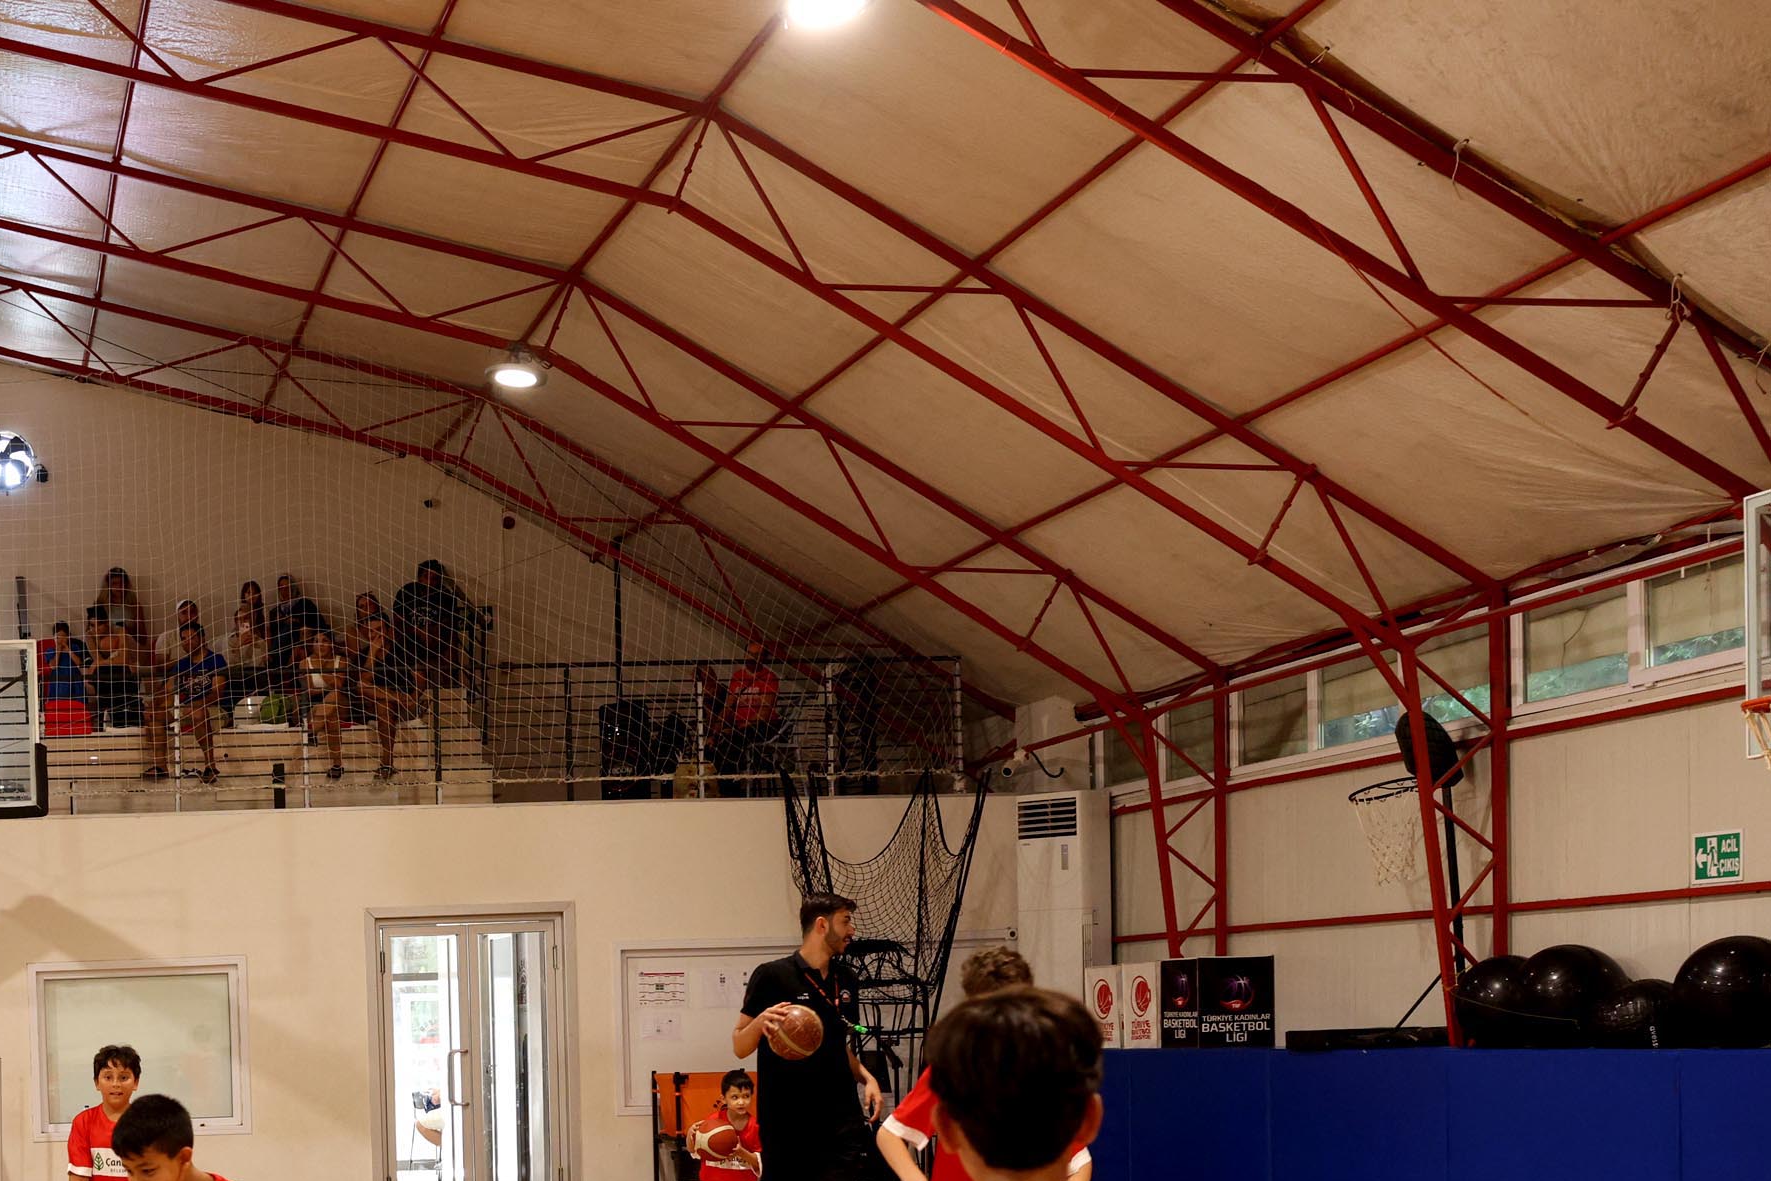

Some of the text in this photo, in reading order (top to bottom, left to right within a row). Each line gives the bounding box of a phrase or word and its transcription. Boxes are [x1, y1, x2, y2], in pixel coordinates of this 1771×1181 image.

[1720, 834, 1739, 853] ACİL
[1719, 857, 1740, 877] ÇIKIŞ
[1234, 1013, 1271, 1021] KADINLAR
[1163, 1019, 1198, 1029] BASKETBOL
[1201, 1020, 1271, 1033] BASKETBOL
[1225, 1031, 1248, 1043] LİGİ
